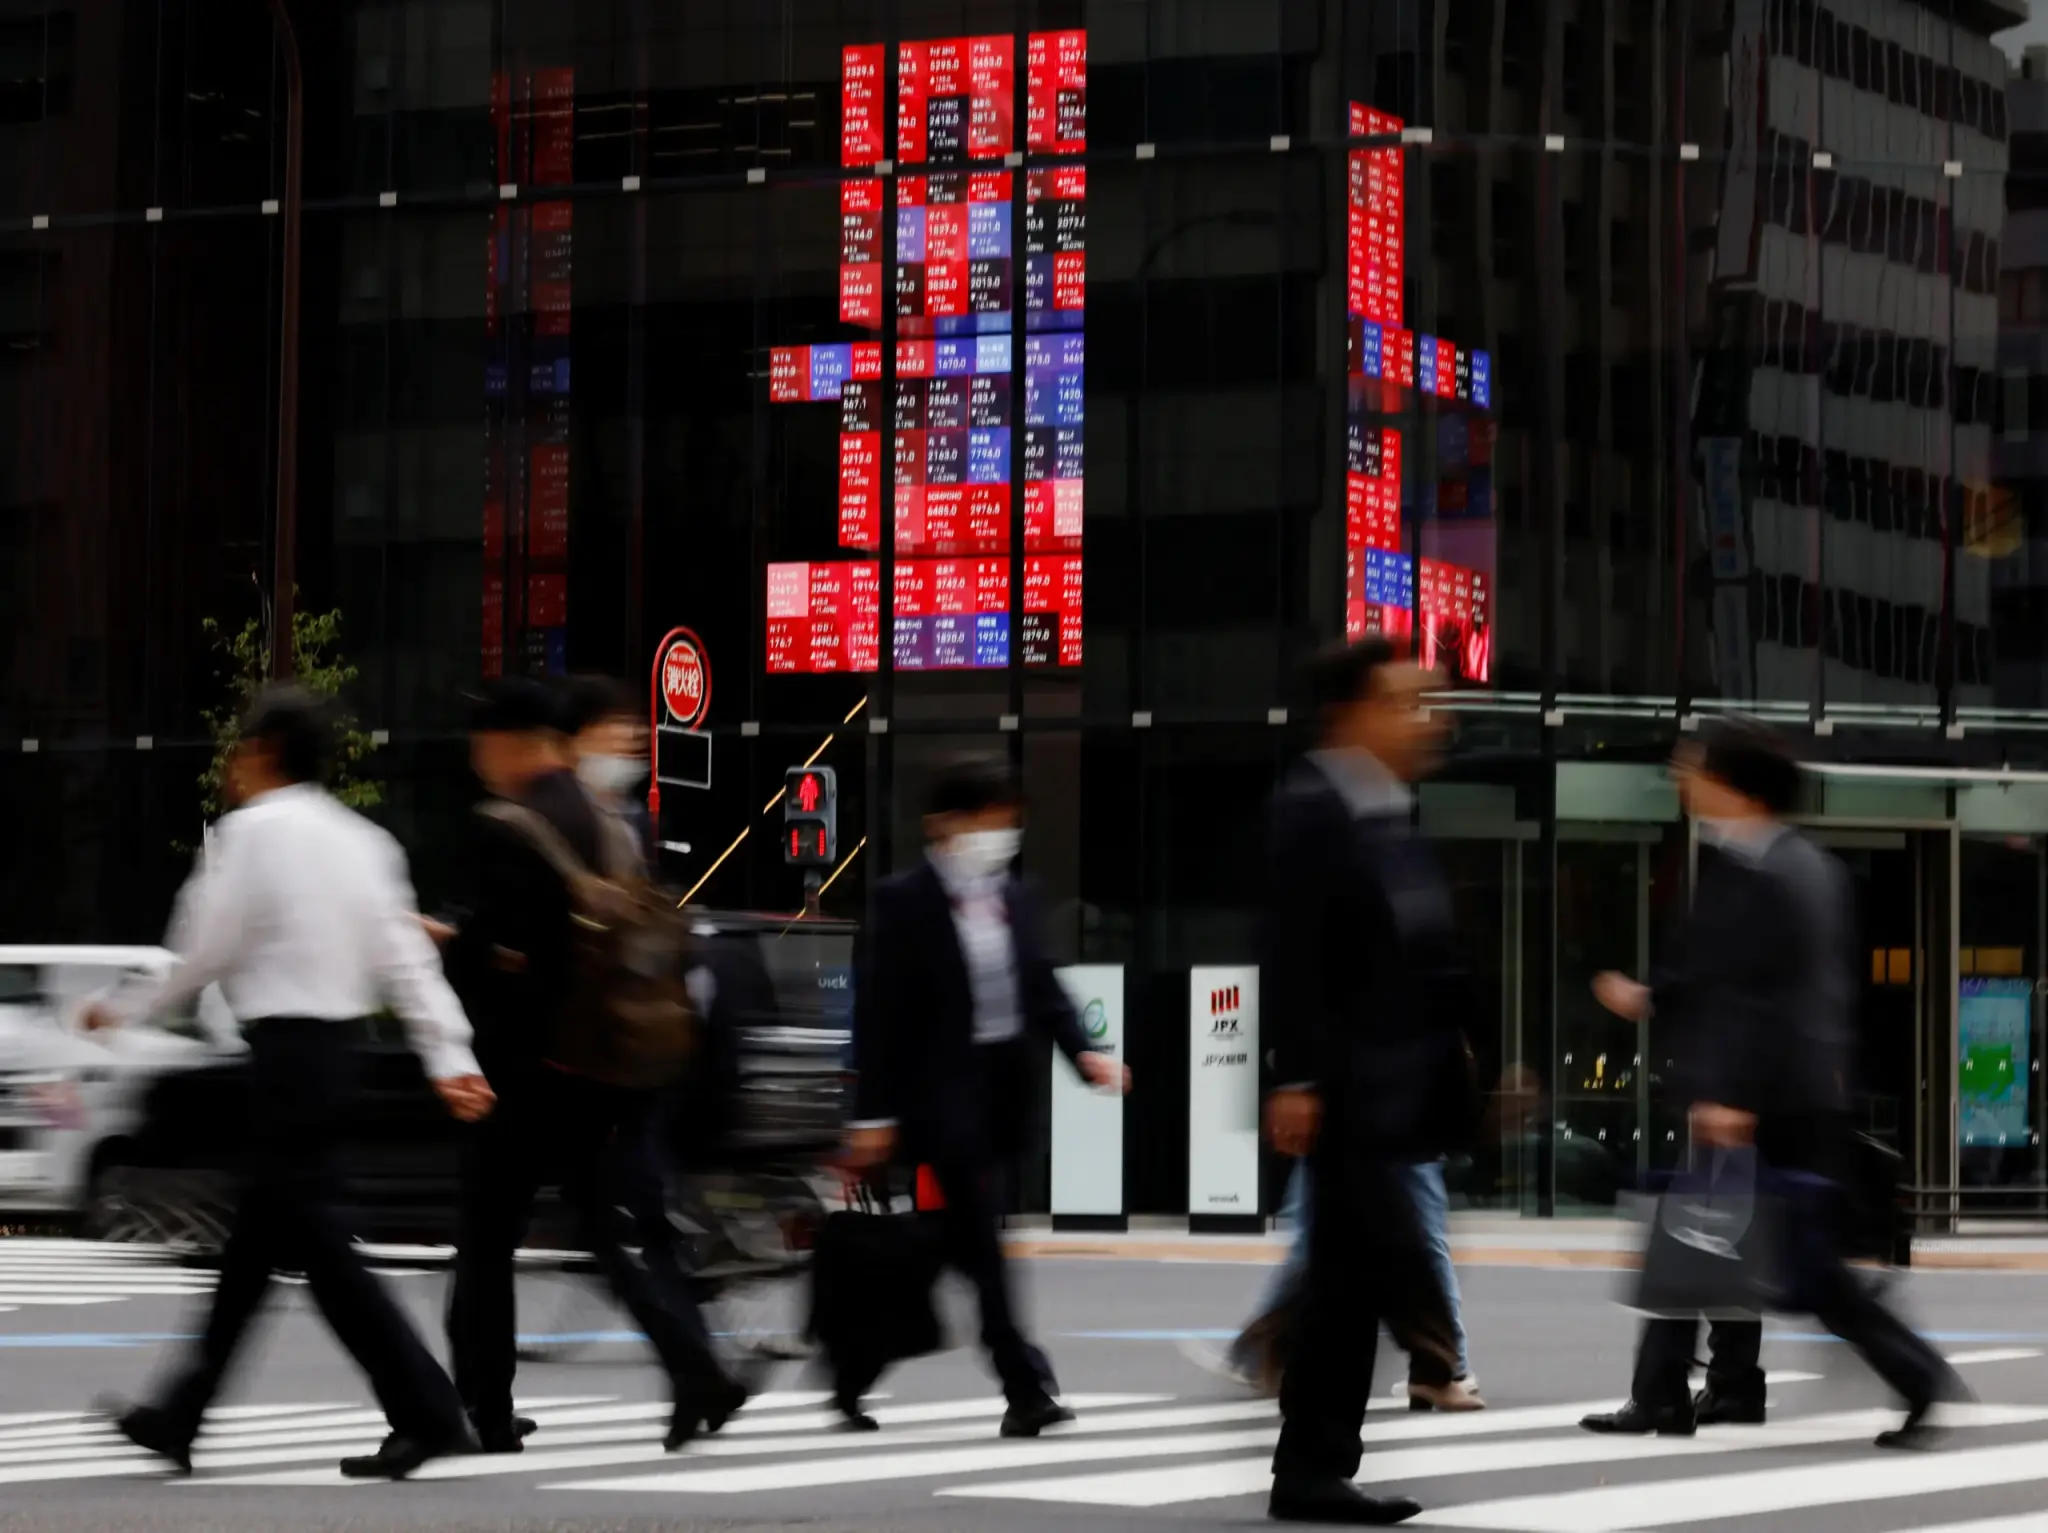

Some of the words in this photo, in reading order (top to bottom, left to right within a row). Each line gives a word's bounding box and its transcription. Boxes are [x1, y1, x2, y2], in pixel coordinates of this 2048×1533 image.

[667, 664, 699, 698] 消火栓
[1211, 1019, 1238, 1032] JPX
